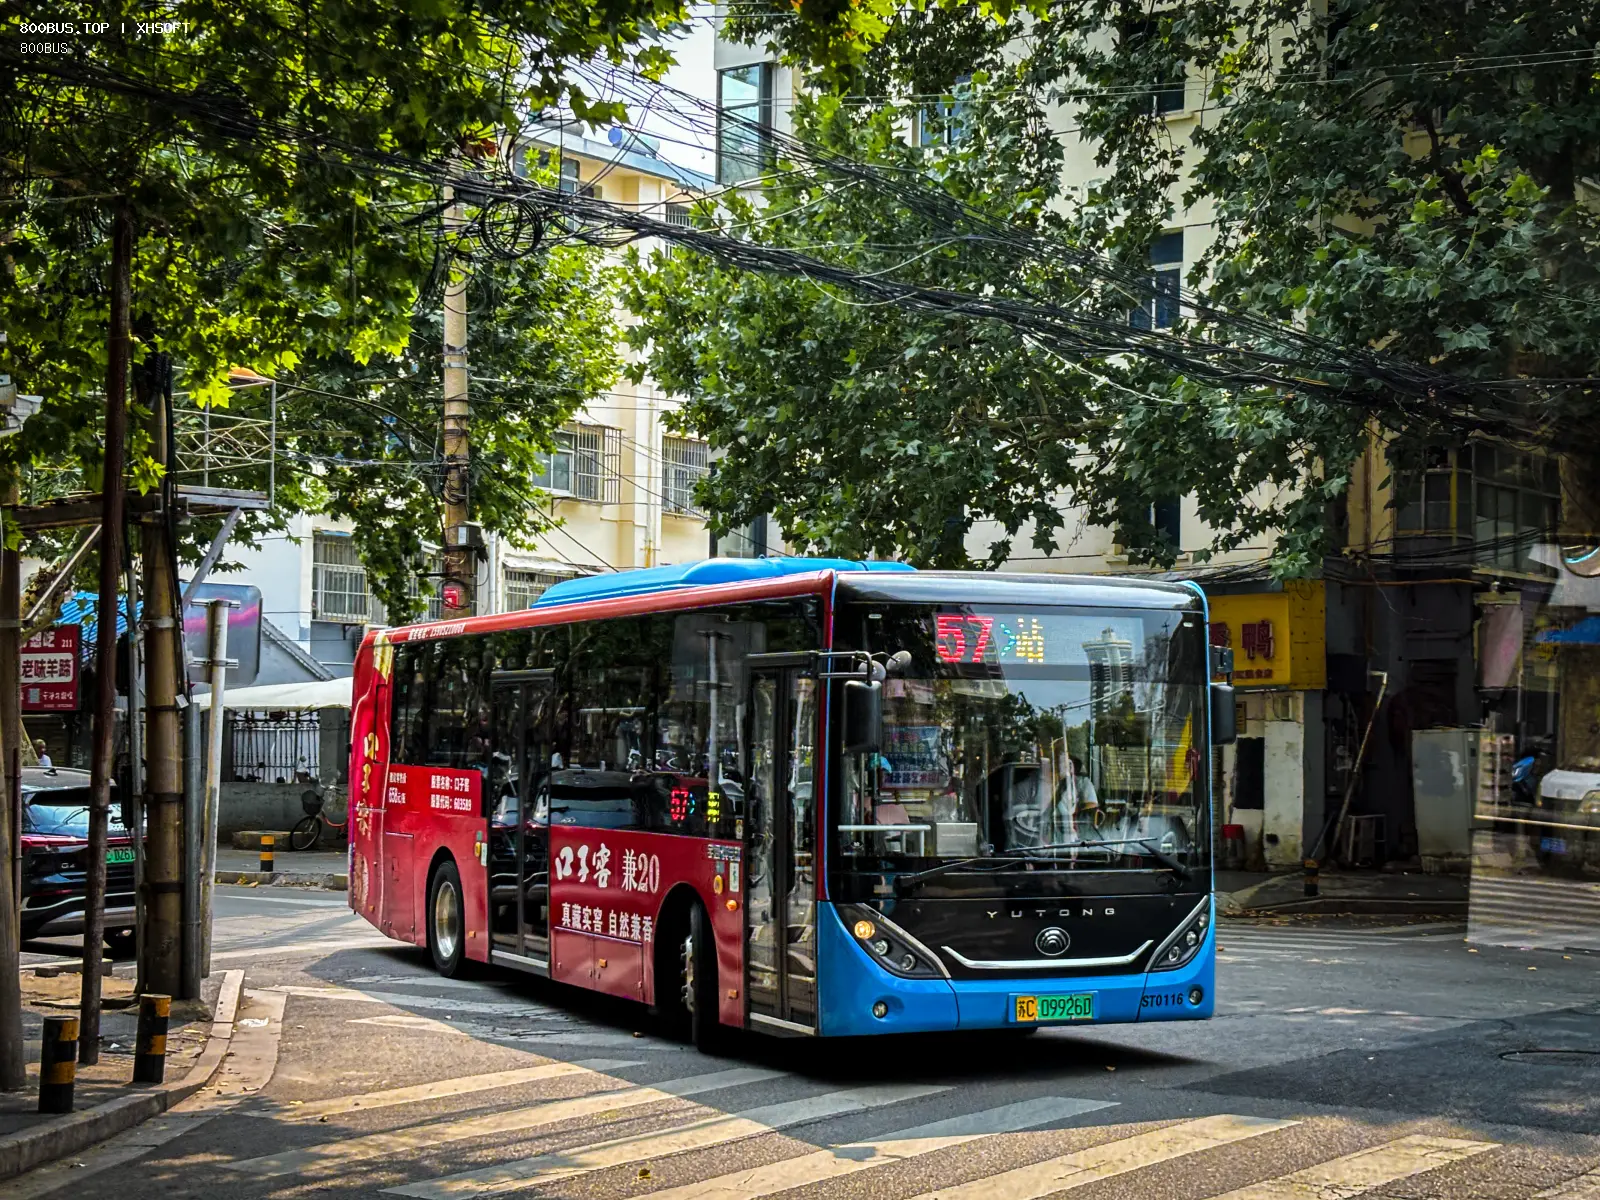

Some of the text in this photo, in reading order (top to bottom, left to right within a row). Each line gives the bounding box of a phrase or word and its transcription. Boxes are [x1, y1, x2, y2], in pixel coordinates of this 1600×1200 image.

[61, 639, 73, 649] 211
[937, 615, 994, 663] 57
[670, 788, 688, 821] 57
[561, 902, 653, 943] 真藏实窖 自然兼香
[986, 906, 1117, 919] YUTONG
[1141, 992, 1184, 1008] ST0116
